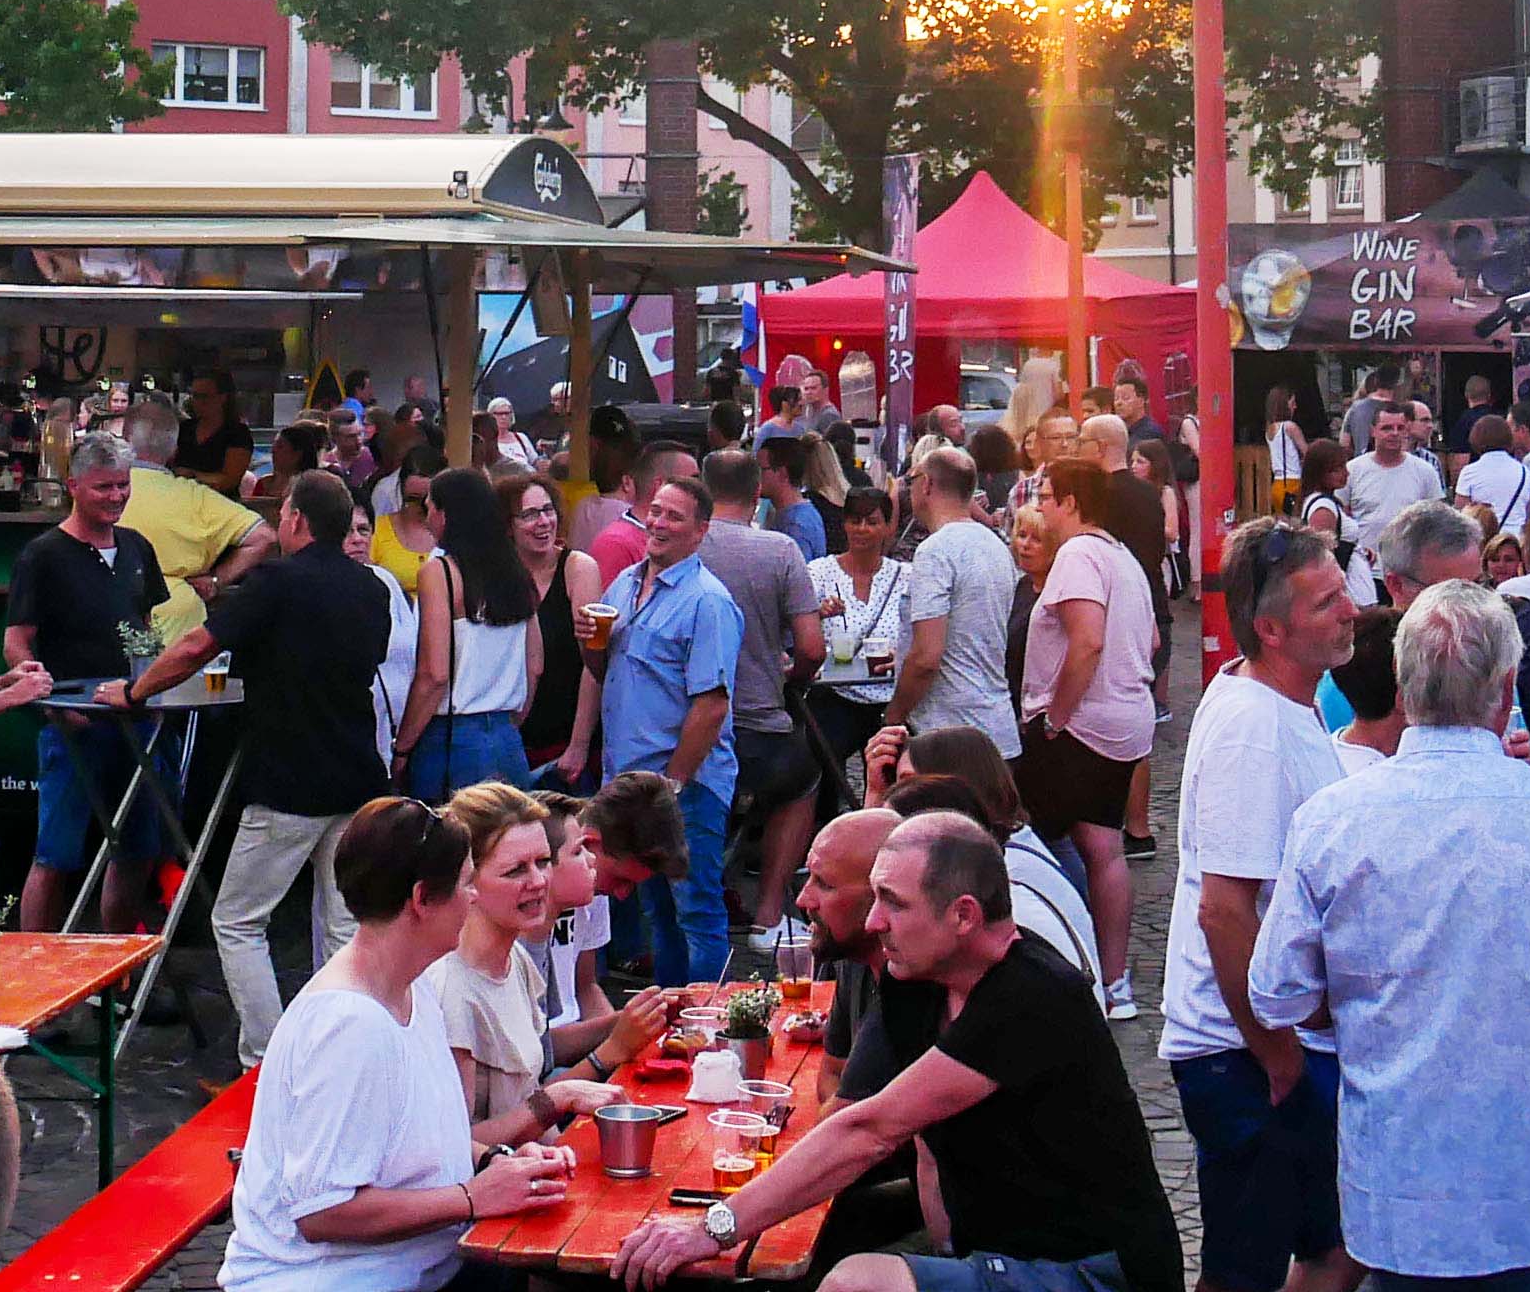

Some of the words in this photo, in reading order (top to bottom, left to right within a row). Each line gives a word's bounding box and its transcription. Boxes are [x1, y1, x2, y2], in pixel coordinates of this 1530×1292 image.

[1353, 230, 1421, 262] WINE
[1351, 266, 1416, 304] GIN
[1349, 308, 1416, 340] BAR
[1, 776, 27, 791] the
